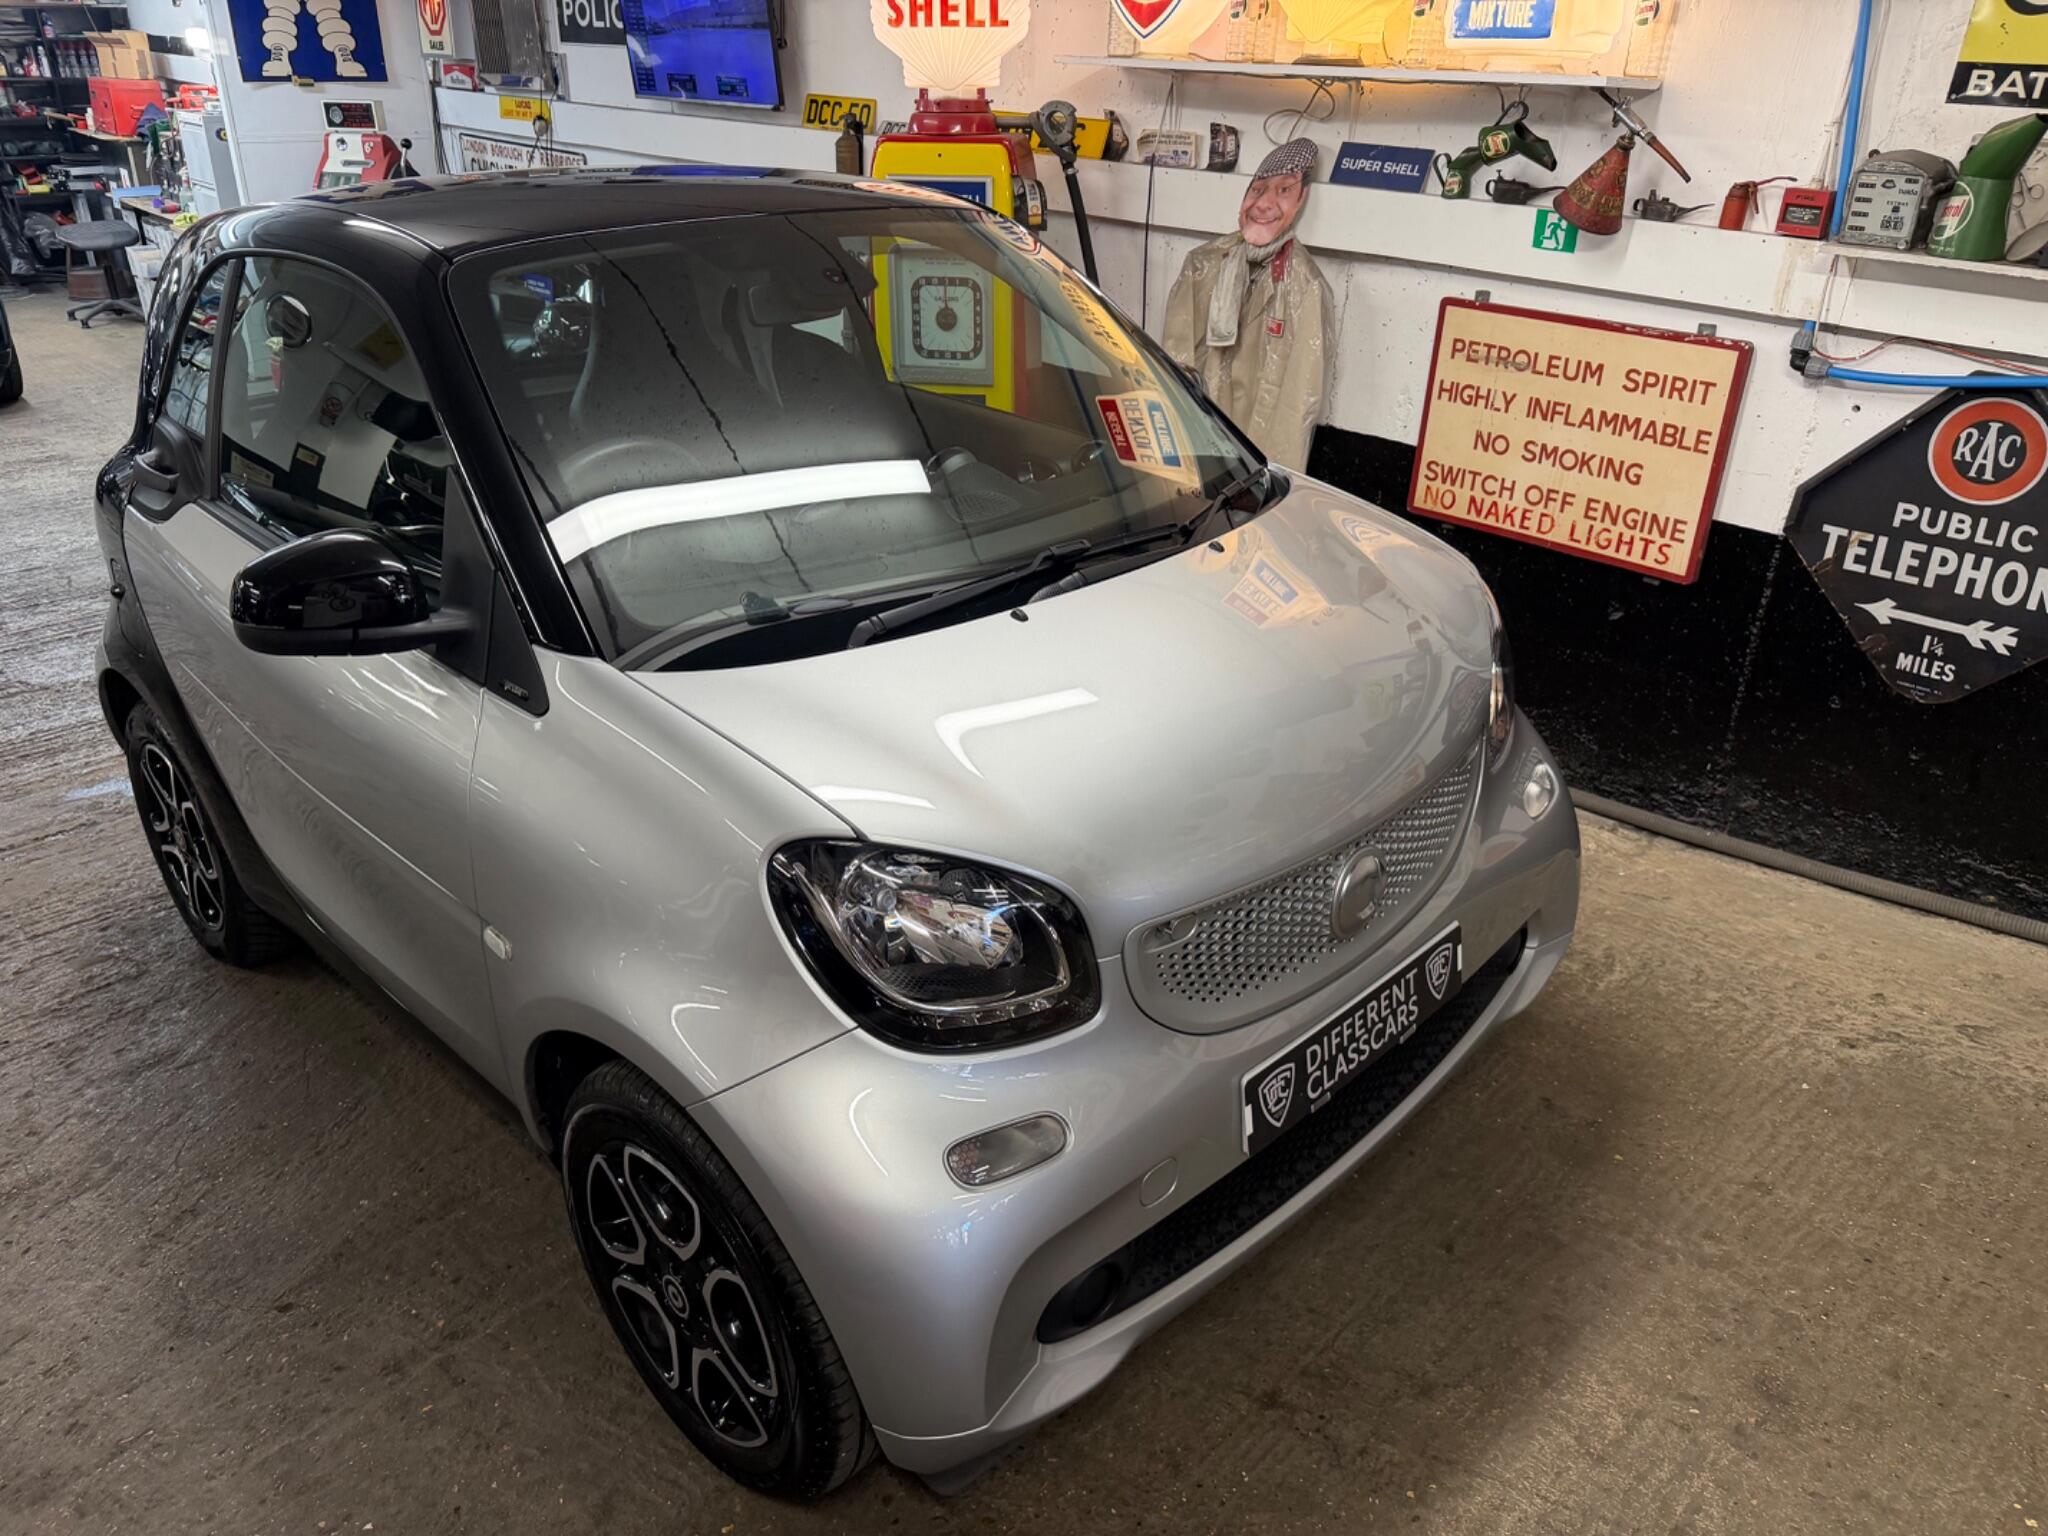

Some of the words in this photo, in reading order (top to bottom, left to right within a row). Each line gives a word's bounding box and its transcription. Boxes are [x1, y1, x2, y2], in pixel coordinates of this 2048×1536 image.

[887, 0, 1009, 28] SHELL
[1467, 0, 1536, 30] MIXTURE
[806, 98, 843, 126] DCC
[1965, 68, 2048, 100] BAT
[1341, 157, 1382, 173] SUPER
[1383, 161, 1420, 177] SHELL
[1451, 338, 1605, 386] PETROLEUM
[1622, 368, 1717, 406] SPIRIT
[1437, 379, 1517, 414] HIGHLY
[1526, 396, 1713, 455] INFLAMMABLE
[1473, 430, 1510, 455] NO
[1521, 439, 1644, 486] SMOKING
[1423, 485, 1457, 510] NO
[1467, 494, 1556, 536] NAKED
[1568, 519, 1673, 566] LIGHTS
[1424, 460, 1517, 501] SWITCH
[1524, 484, 1576, 514] OFF
[1583, 498, 1688, 543] ENGINE
[1892, 501, 2039, 553] PUBLIC
[1821, 523, 2048, 614] TELEPHON
[1895, 652, 1956, 682] MILES
[1306, 968, 1419, 1074] DIFFERENT
[1306, 995, 1419, 1100] CLASSCARS
